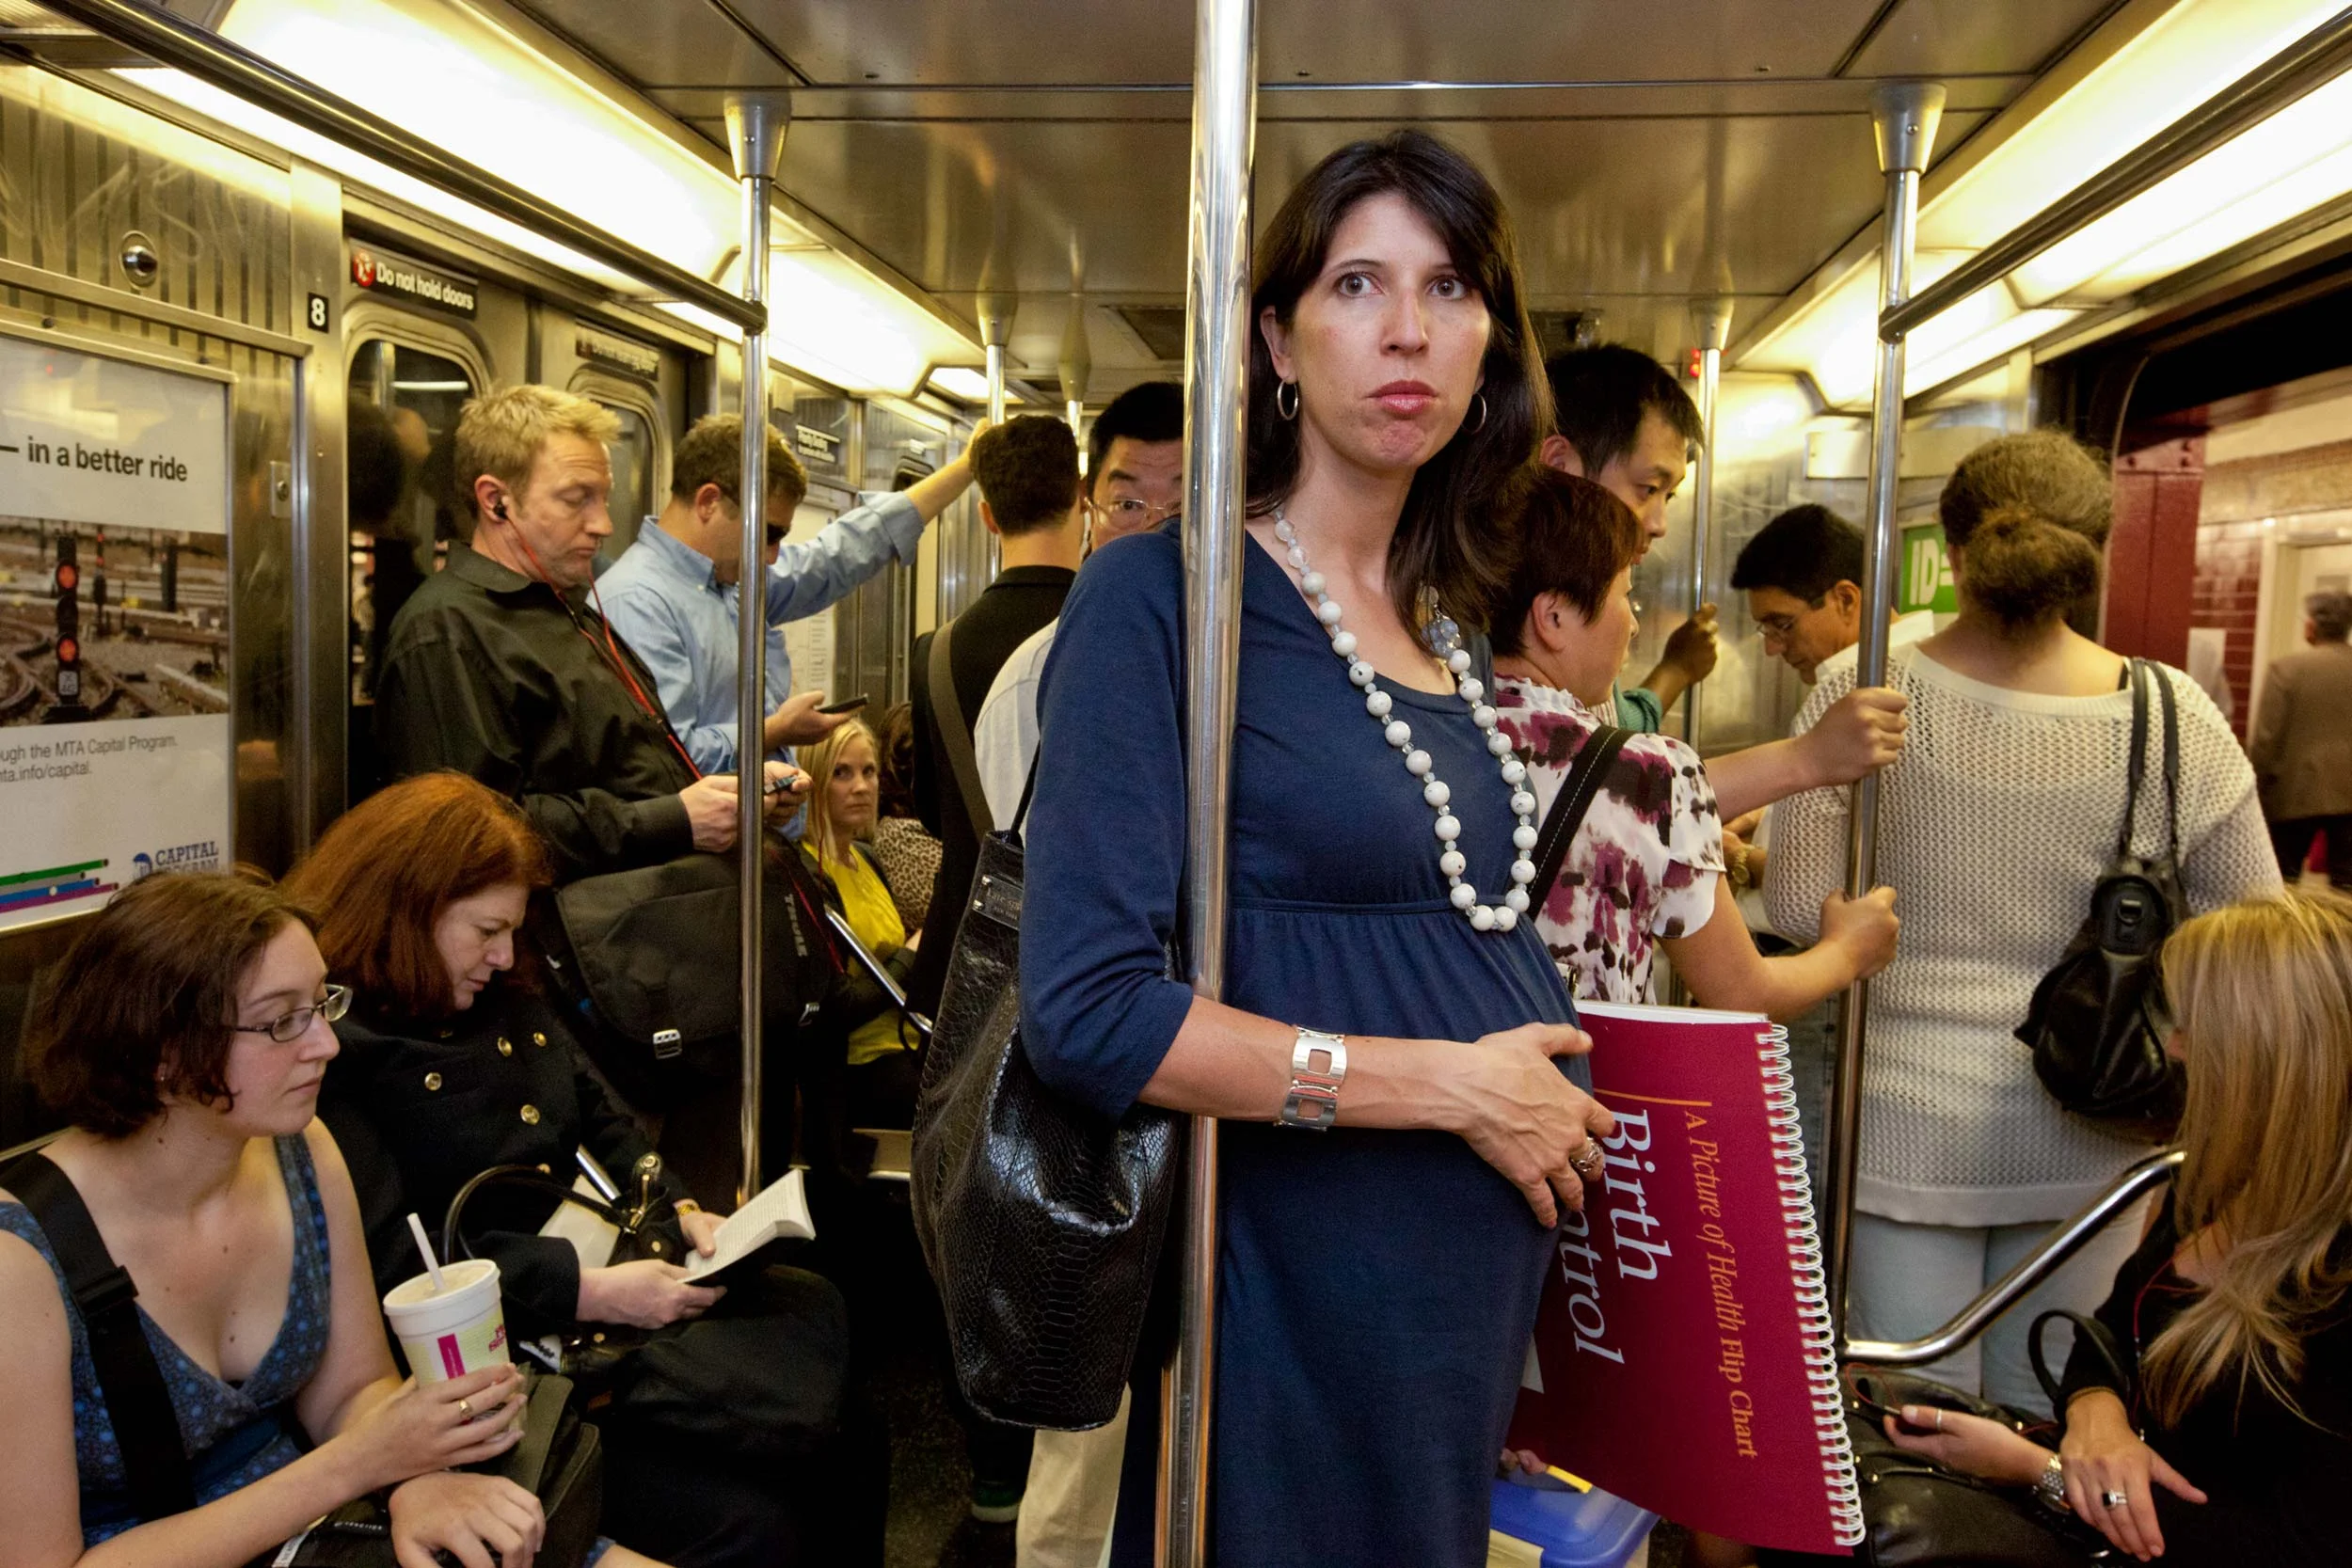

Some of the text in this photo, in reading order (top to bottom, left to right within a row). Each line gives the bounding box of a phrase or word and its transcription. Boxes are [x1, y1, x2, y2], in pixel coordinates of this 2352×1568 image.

[376, 261, 474, 310] Do not hold doors
[310, 297, 326, 327] 8
[27, 436, 50, 464] in
[56, 447, 70, 467] a
[75, 442, 143, 476] better
[150, 454, 187, 482] ride
[30, 744, 51, 759] the
[56, 739, 85, 756] MTA
[87, 736, 125, 755] Capital
[156, 841, 218, 866] CAPITAL
[1602, 1109, 1673, 1280] Birth
[1559, 1210, 1625, 1364] ntrol
[1685, 1111, 1757, 1458] A Picture of Health Flip Chart
